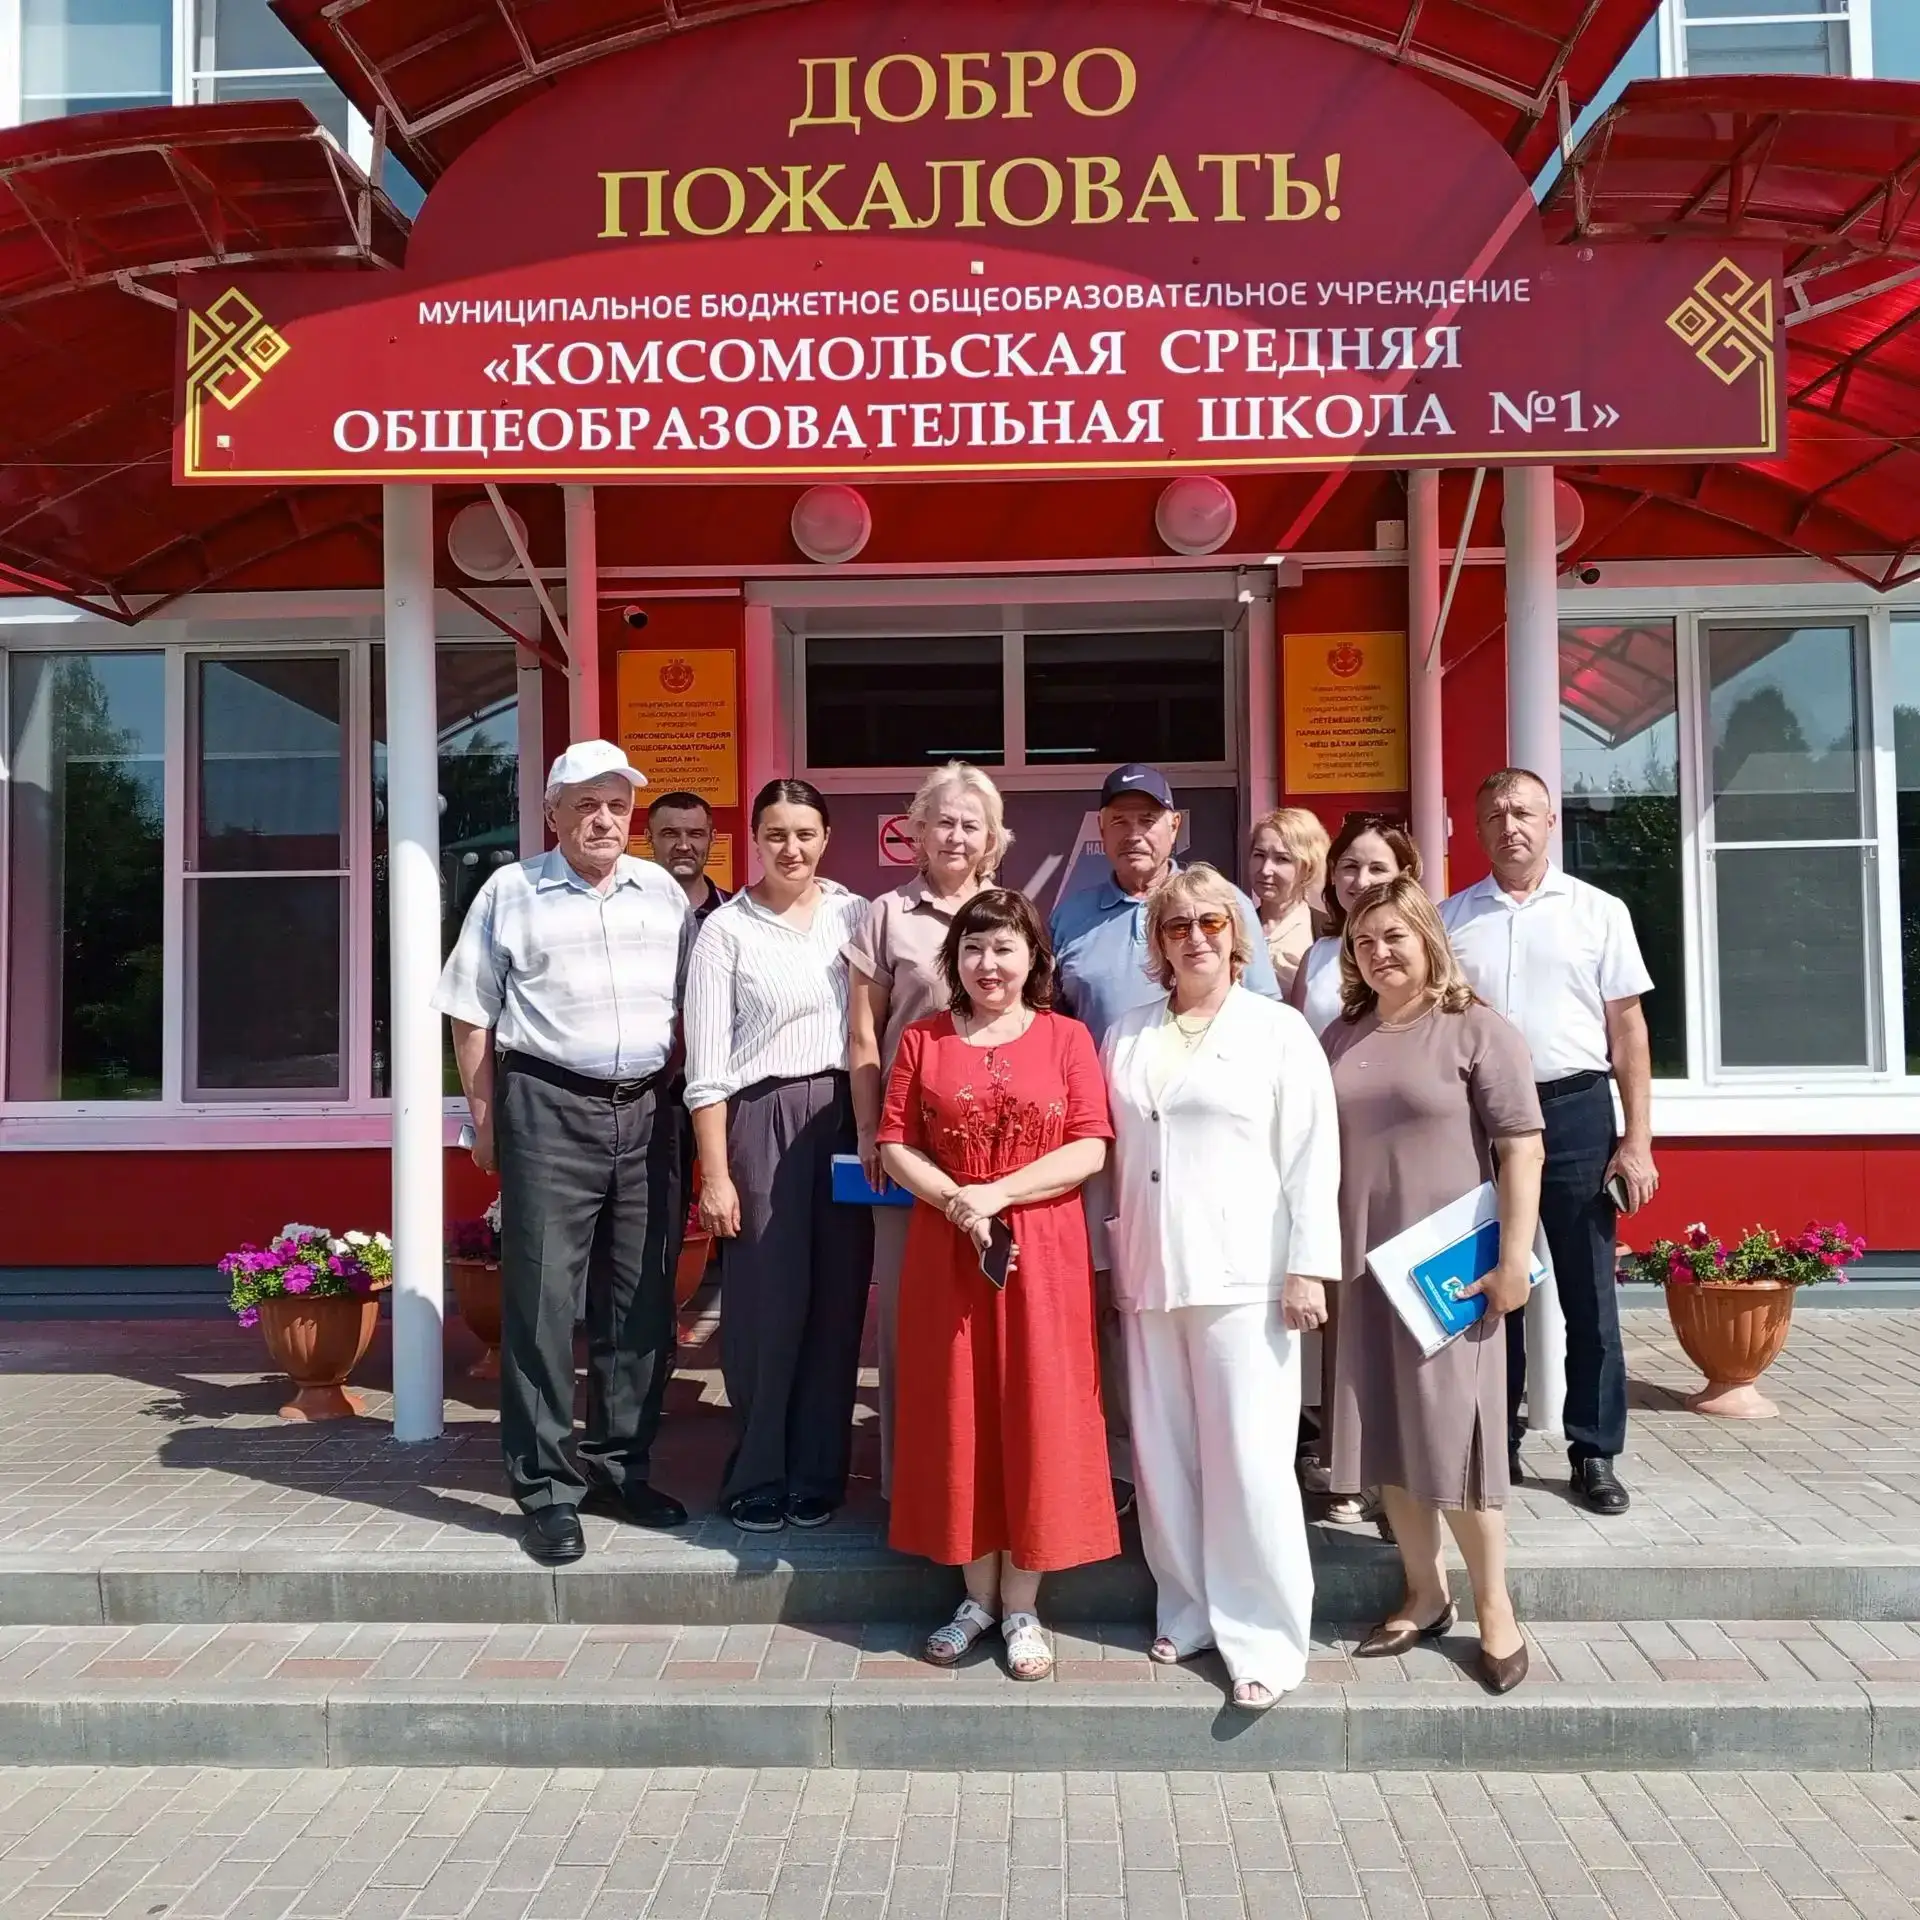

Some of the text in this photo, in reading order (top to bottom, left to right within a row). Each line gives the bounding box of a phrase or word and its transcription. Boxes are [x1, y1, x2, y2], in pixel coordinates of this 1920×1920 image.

[789, 48, 1138, 139] ДОБРО
[598, 153, 1343, 240] ПОЖАЛОВАТЬ!
[419, 278, 1531, 328] МУНИЦИПАЛЬНОЕ БЮДЖЕТНОЕ ОБЩЕОБРАЗОВАТЕЛЬНОЕ УЧРЕЖДЕНИЕ
[484, 326, 1464, 387] «КОМСОМОЛЬСКАЯ СРЕДНЯЯ
[334, 391, 1621, 460] ОБЩЕОБРАЗОВАТЕЛЬНАЯ ШКОЛА №1»
[629, 743, 726, 752] ОБЩЕОБРАЗОВАТЕЛЬНАЯ
[655, 756, 683, 764] ШКОЛА
[696, 731, 731, 739] СРЕДНЯЯ
